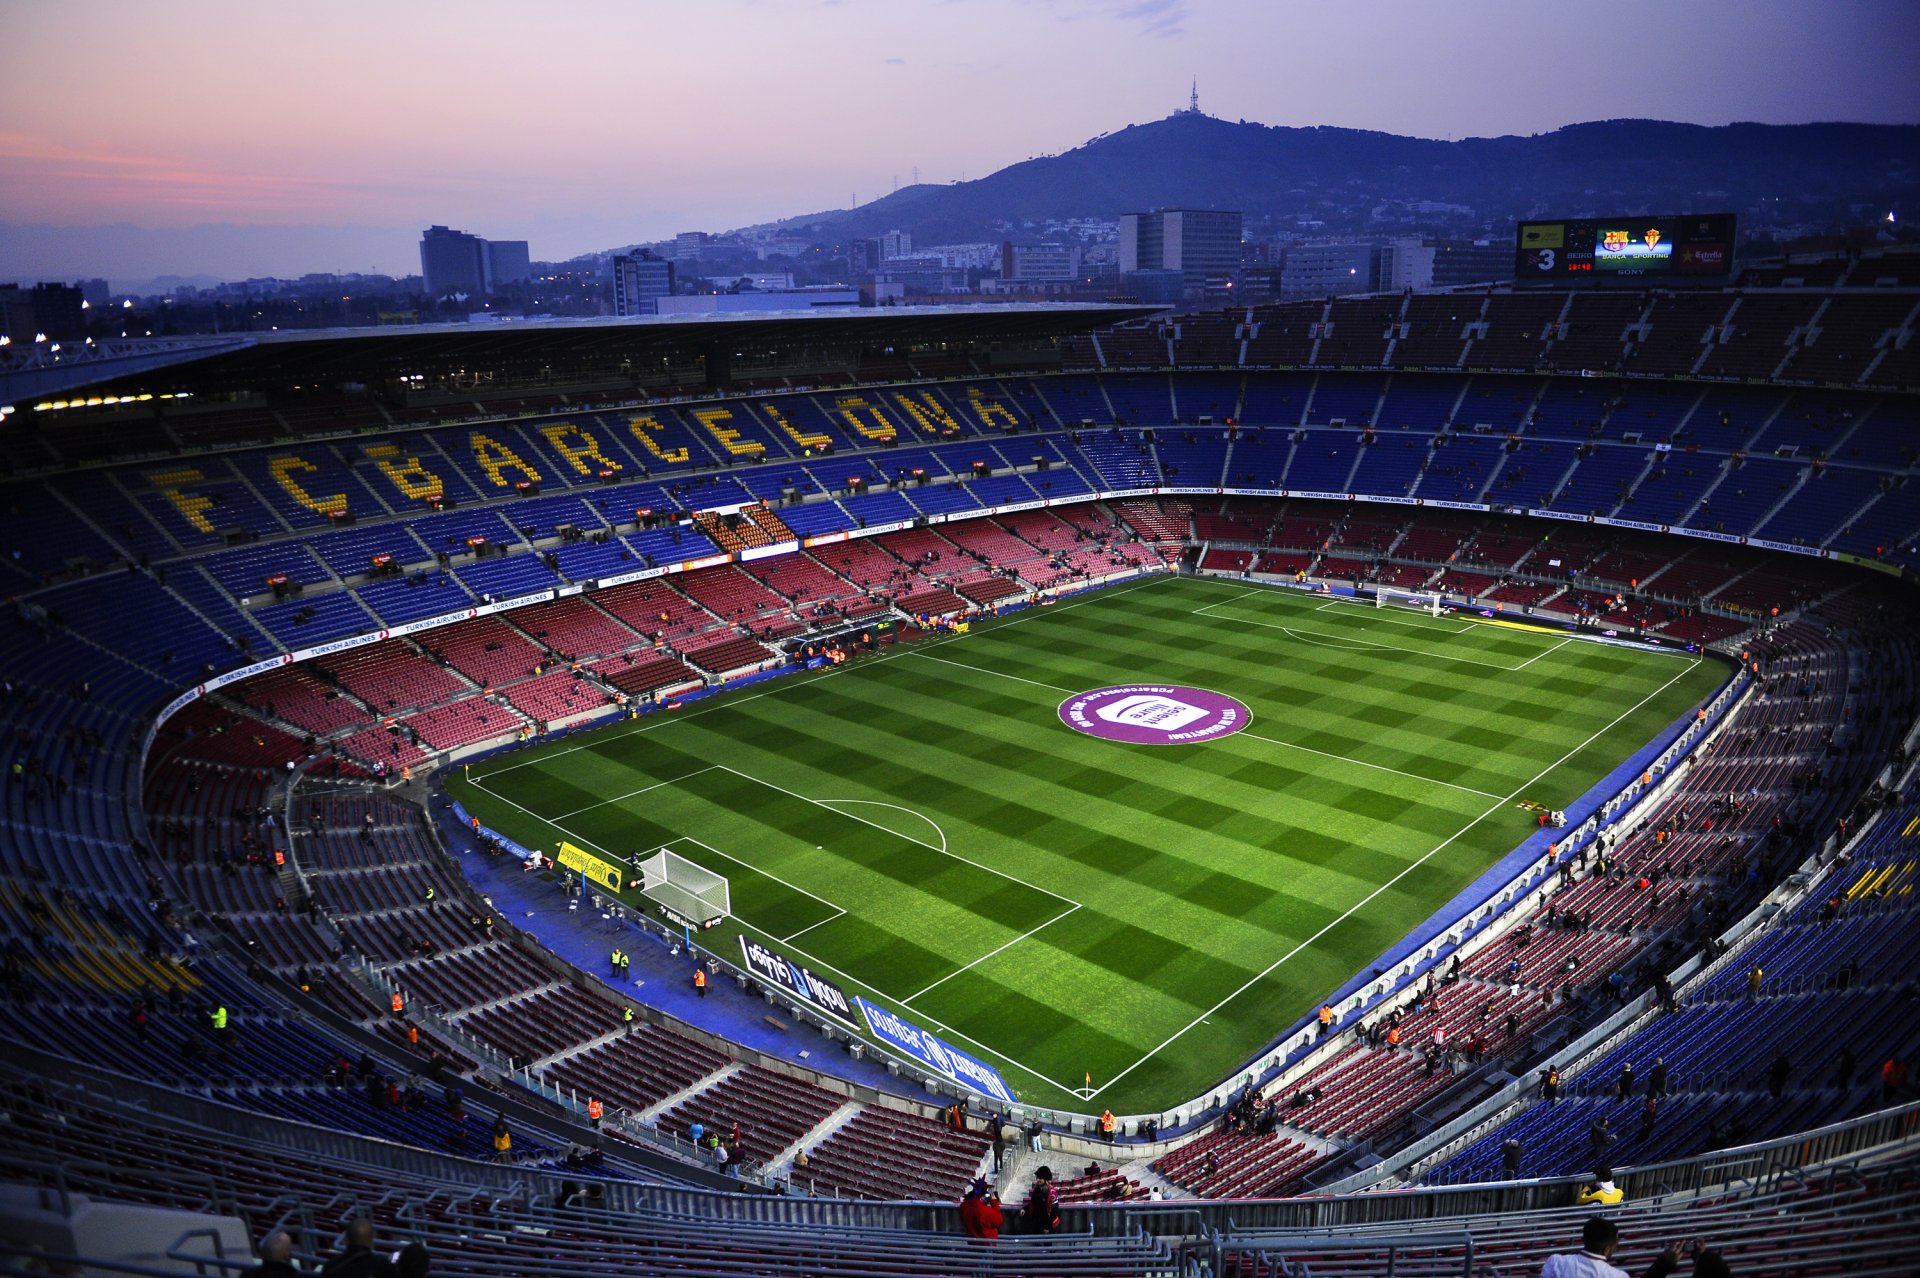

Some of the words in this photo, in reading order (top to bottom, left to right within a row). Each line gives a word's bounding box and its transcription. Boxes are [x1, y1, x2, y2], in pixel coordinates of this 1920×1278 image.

[1695, 250, 1722, 259] Estrella
[876, 524, 896, 532] AIRLINES
[1608, 519, 1632, 527] TURKISH
[1632, 522, 1659, 531] AIRLINES
[1684, 530, 1709, 538] TURKISH
[1710, 533, 1736, 542] AIRLINES
[1762, 541, 1789, 550] TURKISH
[1790, 545, 1818, 556] AIRLINES
[611, 574, 635, 584] TURKISH
[636, 569, 660, 579] AIRLINES
[492, 601, 520, 612] TURKISH
[520, 594, 548, 604] AIRLINES
[406, 620, 436, 632] TURKISH
[436, 612, 466, 625] AIRLINES
[310, 643, 343, 656] TURKISH
[344, 634, 376, 648] AIRLINES
[218, 669, 247, 684] TURKISH
[248, 659, 280, 674] AIRLINES
[1129, 704, 1170, 718] lliure
[1142, 706, 1186, 724] seient
[802, 968, 850, 1013] mobily
[867, 1006, 931, 1061] Seguros
[944, 1047, 1007, 1100] Allianz
